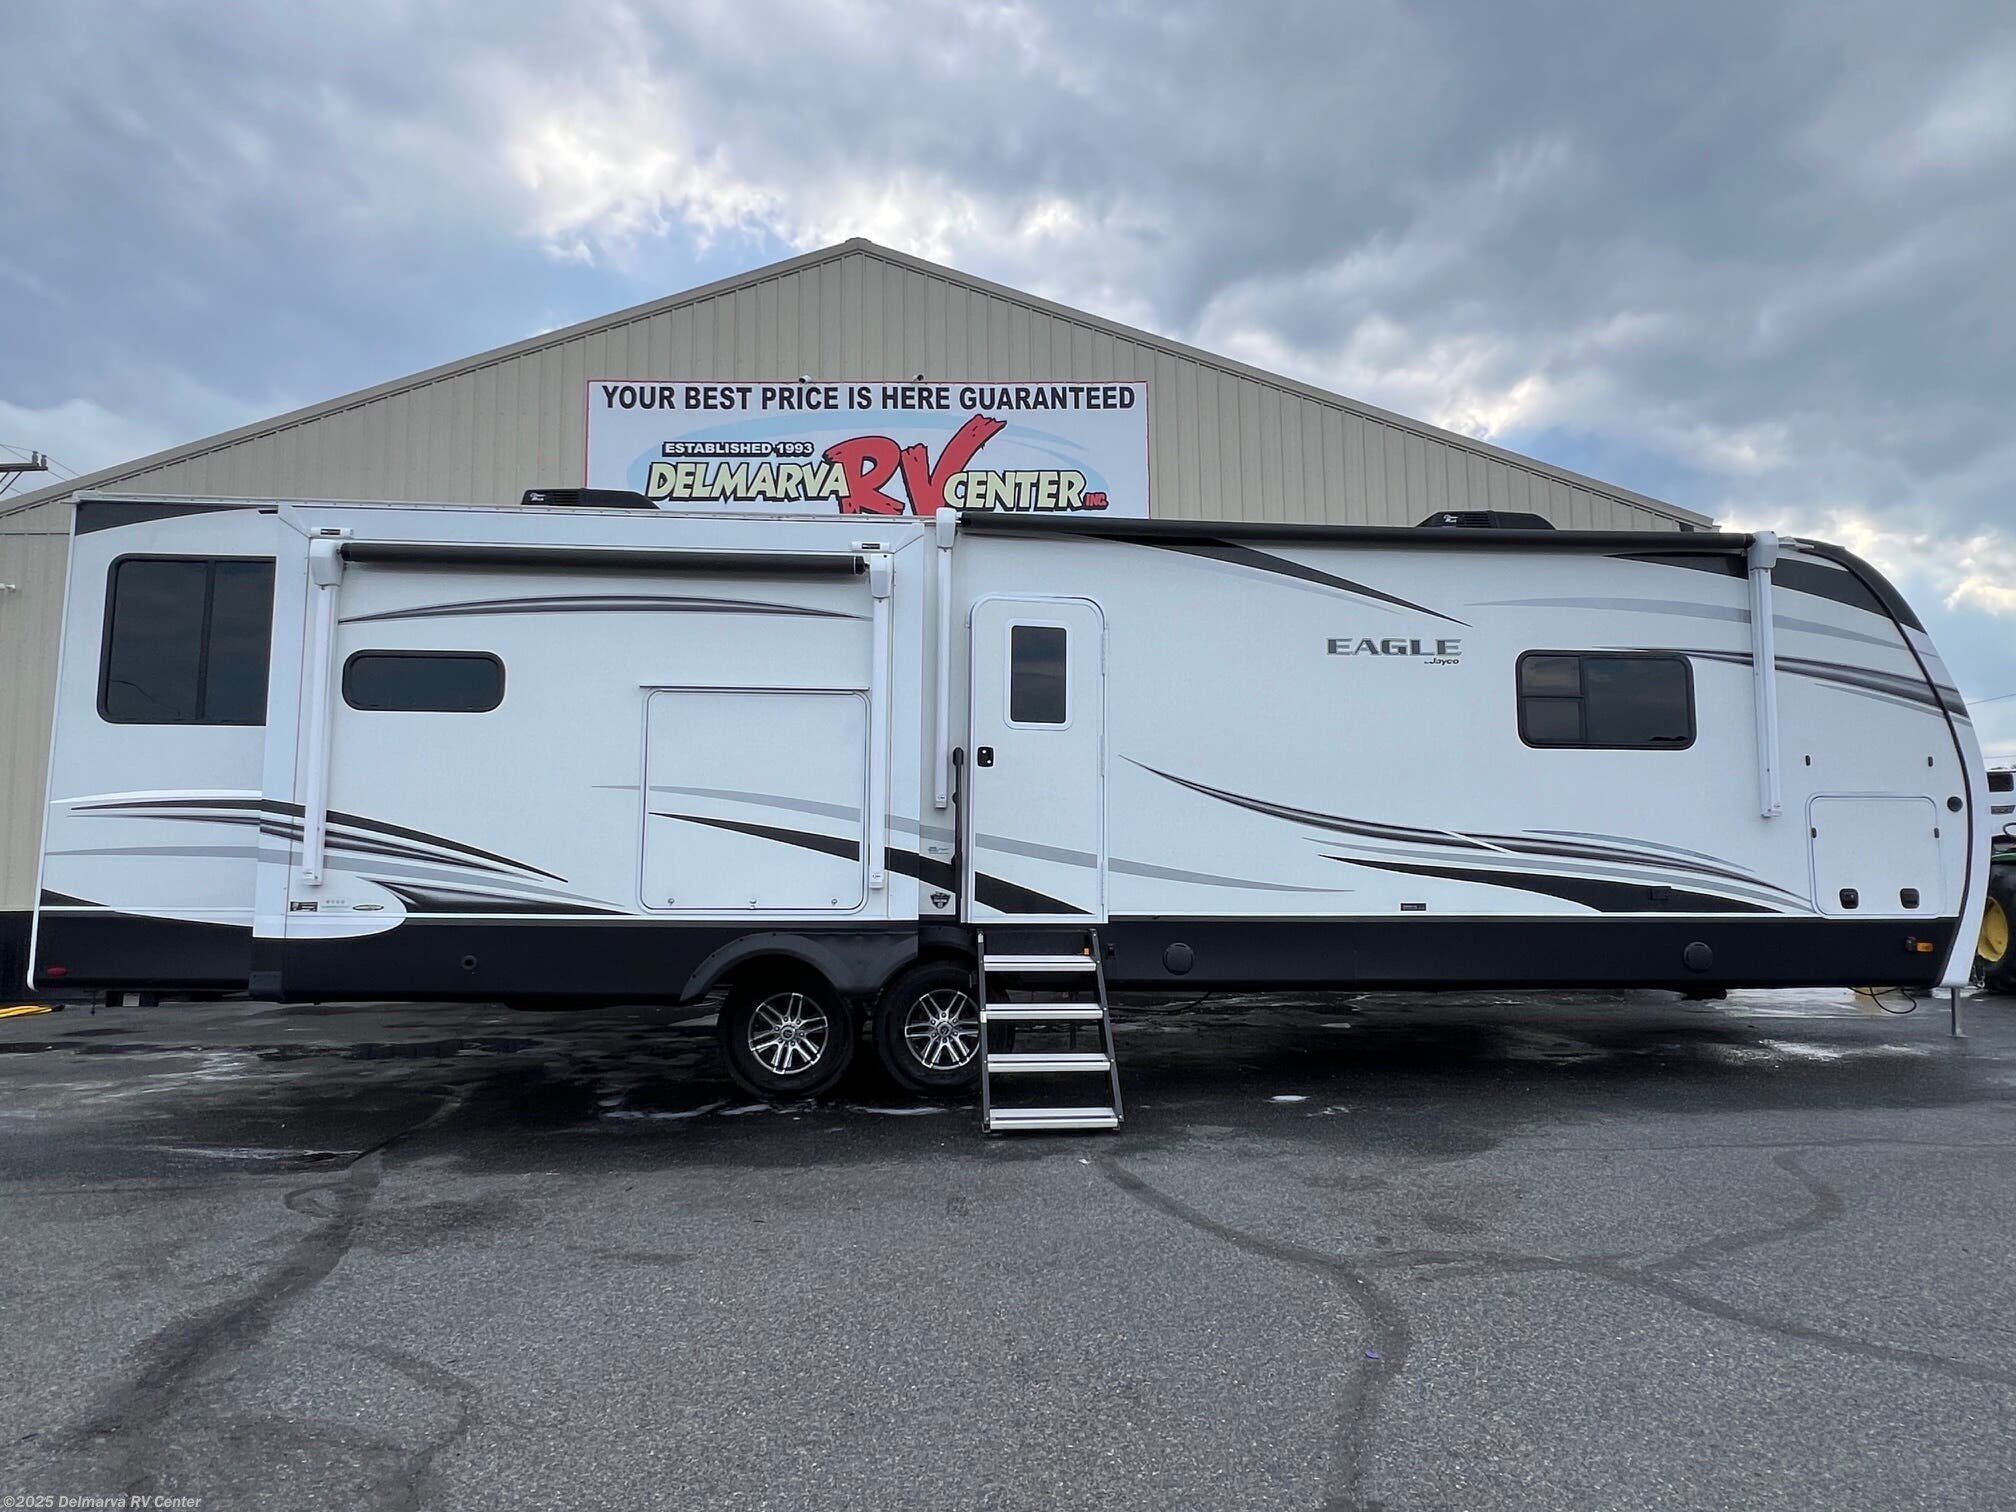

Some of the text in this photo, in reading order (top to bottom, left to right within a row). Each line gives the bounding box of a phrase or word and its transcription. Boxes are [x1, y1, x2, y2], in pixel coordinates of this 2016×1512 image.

[602, 385, 1135, 410] YOUR BEST PRICE IS HERE GUARANTEED
[664, 442, 813, 455] ESTABLISHED 1993
[647, 461, 850, 501] DELMARVA
[822, 414, 1007, 514] RV
[944, 469, 1086, 511] CENTER
[1327, 637, 1463, 656] EAGLE
[1430, 657, 1460, 666] Jayco
